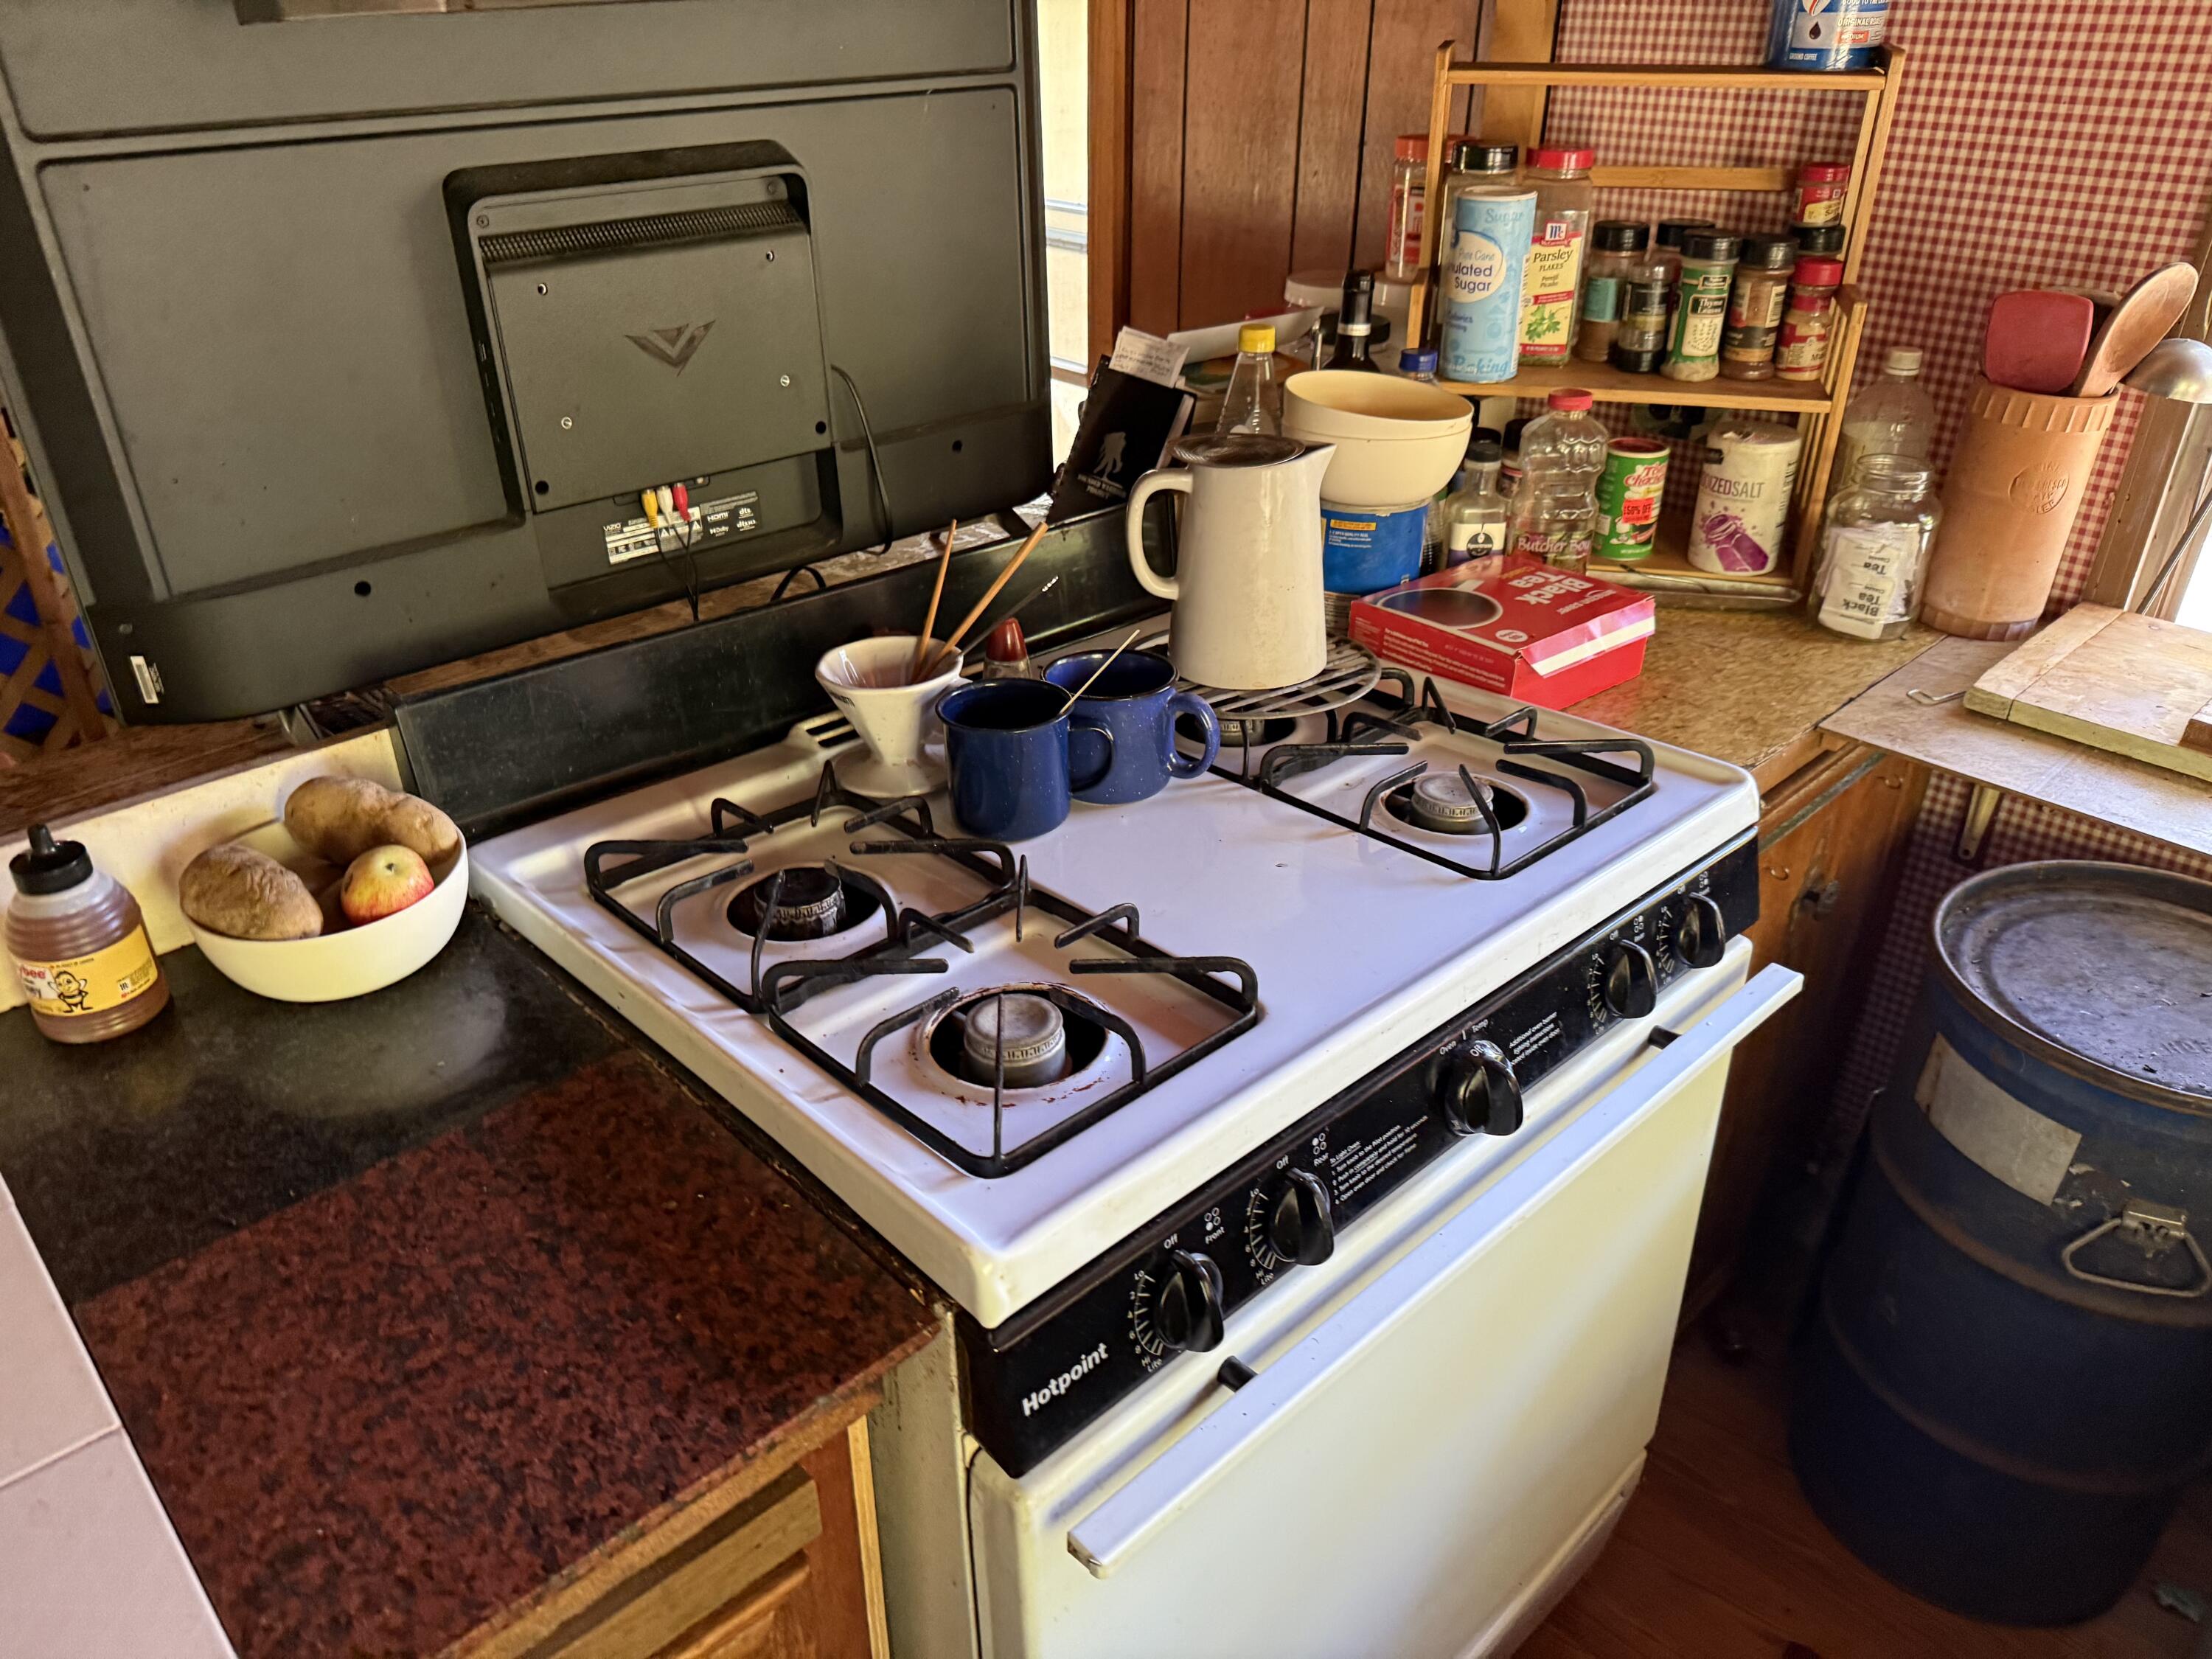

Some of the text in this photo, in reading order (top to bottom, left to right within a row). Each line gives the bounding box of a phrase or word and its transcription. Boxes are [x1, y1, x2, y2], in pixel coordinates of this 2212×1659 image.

[1485, 209, 1525, 226] Sugar
[1475, 249, 1495, 261] Cane
[1534, 248, 1573, 262] Parsley
[1454, 262, 1493, 276] ulated
[1540, 263, 1564, 272] FLAKES
[1455, 276, 1492, 293] Sugar
[707, 511, 729, 522] HDMI
[603, 522, 622, 531] VIZIO
[1517, 536, 1567, 553] Butcher
[1863, 561, 1887, 576] Tea
[1508, 571, 1567, 588] Tea
[1514, 577, 1595, 605] Black
[1858, 591, 1880, 606] Tea
[1843, 597, 1879, 616] Black
[1472, 1019, 1489, 1032] Temp
[1439, 1040, 1457, 1055] Oven
[1470, 1044, 1484, 1057] Off
[1314, 1152, 1328, 1166] Rear
[1336, 1150, 1347, 1160] Light
[1347, 1155, 1359, 1164] knob
[1364, 1144, 1372, 1152] the
[1276, 1155, 1289, 1169] Off
[1250, 1188, 1259, 1197] Lo
[1340, 1189, 1354, 1201] Open
[1164, 1233, 1178, 1249] Off
[1205, 1226, 1225, 1245] Front
[1134, 1270, 1145, 1281] Lo
[1260, 1273, 1274, 1285] Lite
[1022, 1342, 1109, 1417] Hotpoint
